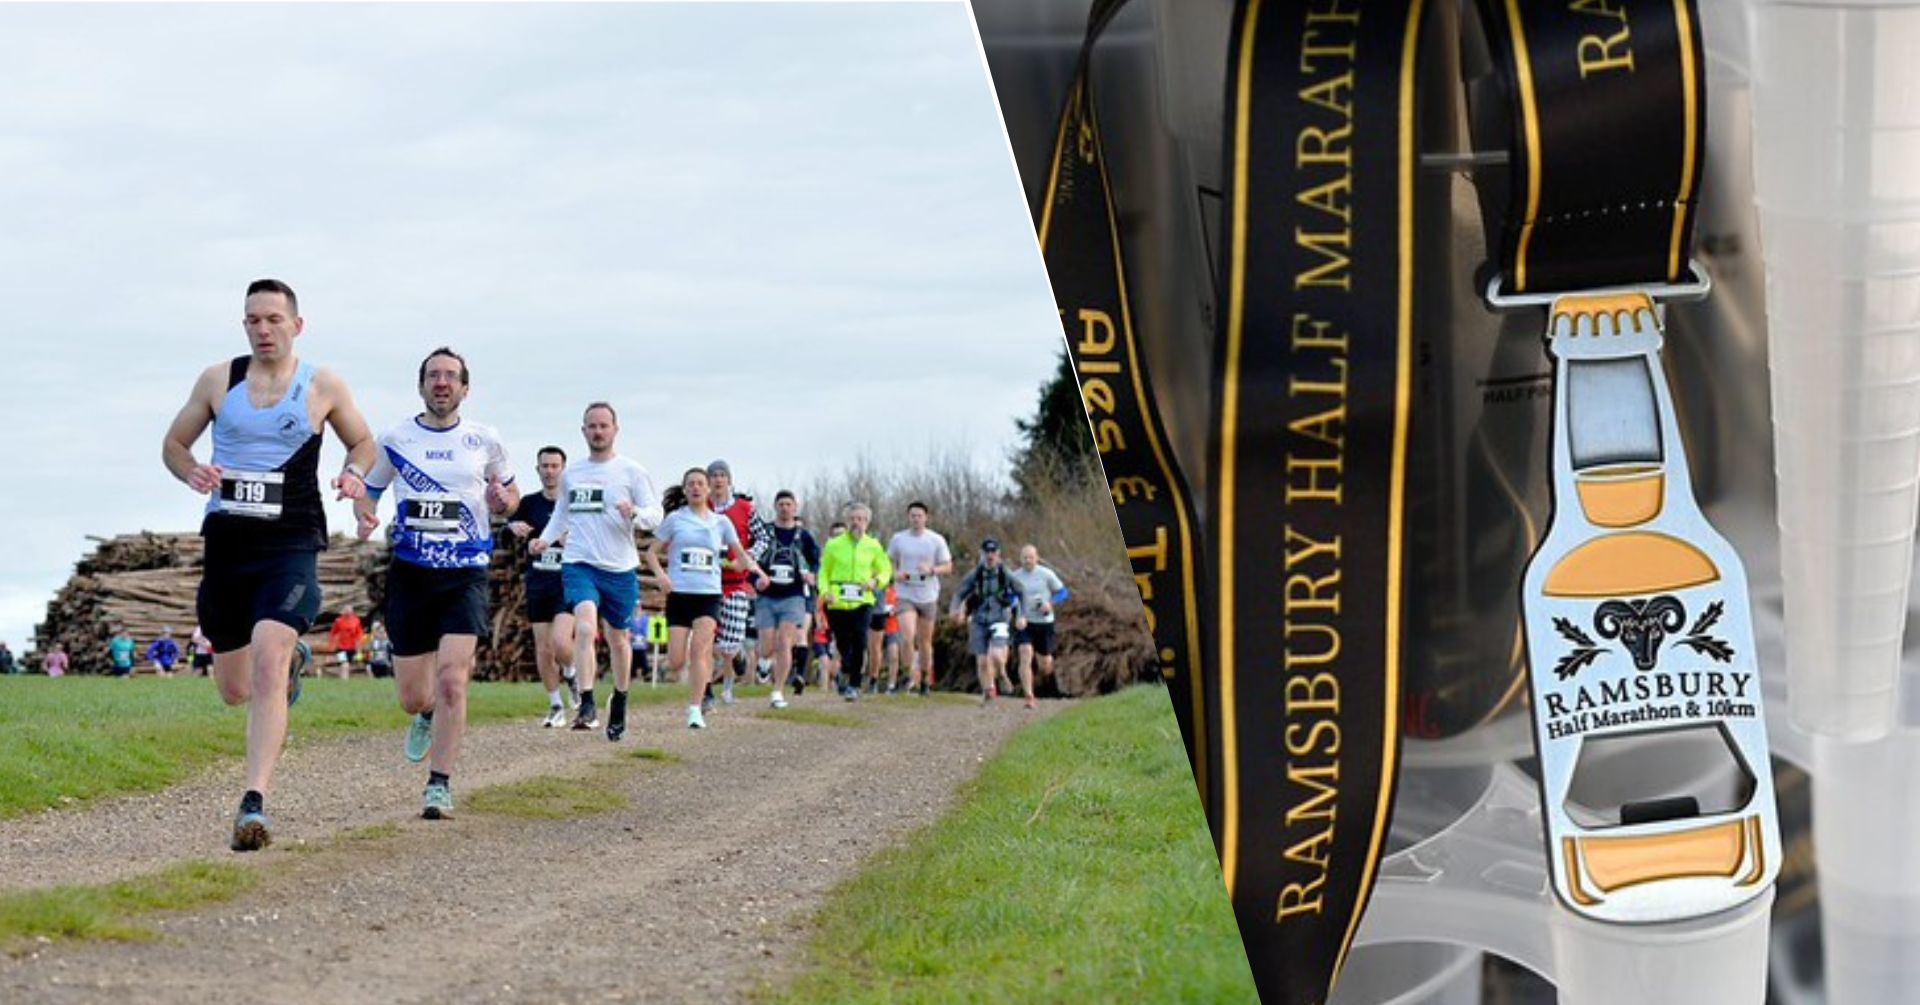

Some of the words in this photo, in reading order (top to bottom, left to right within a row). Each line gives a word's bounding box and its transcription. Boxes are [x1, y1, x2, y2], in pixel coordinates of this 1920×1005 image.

[1079, 308, 1127, 454] Ales
[1285, 313, 1350, 506] HALF
[425, 450, 454, 461] MIKE
[235, 481, 266, 503] 819
[418, 502, 445, 519] 712
[1544, 671, 1752, 719] RAMSBURY
[1276, 526, 1341, 924] RAMSBURY
[1546, 712, 1590, 739] Half
[1593, 704, 1681, 729] Marathon
[1686, 699, 1701, 718] &
[1707, 699, 1756, 718] 10km
